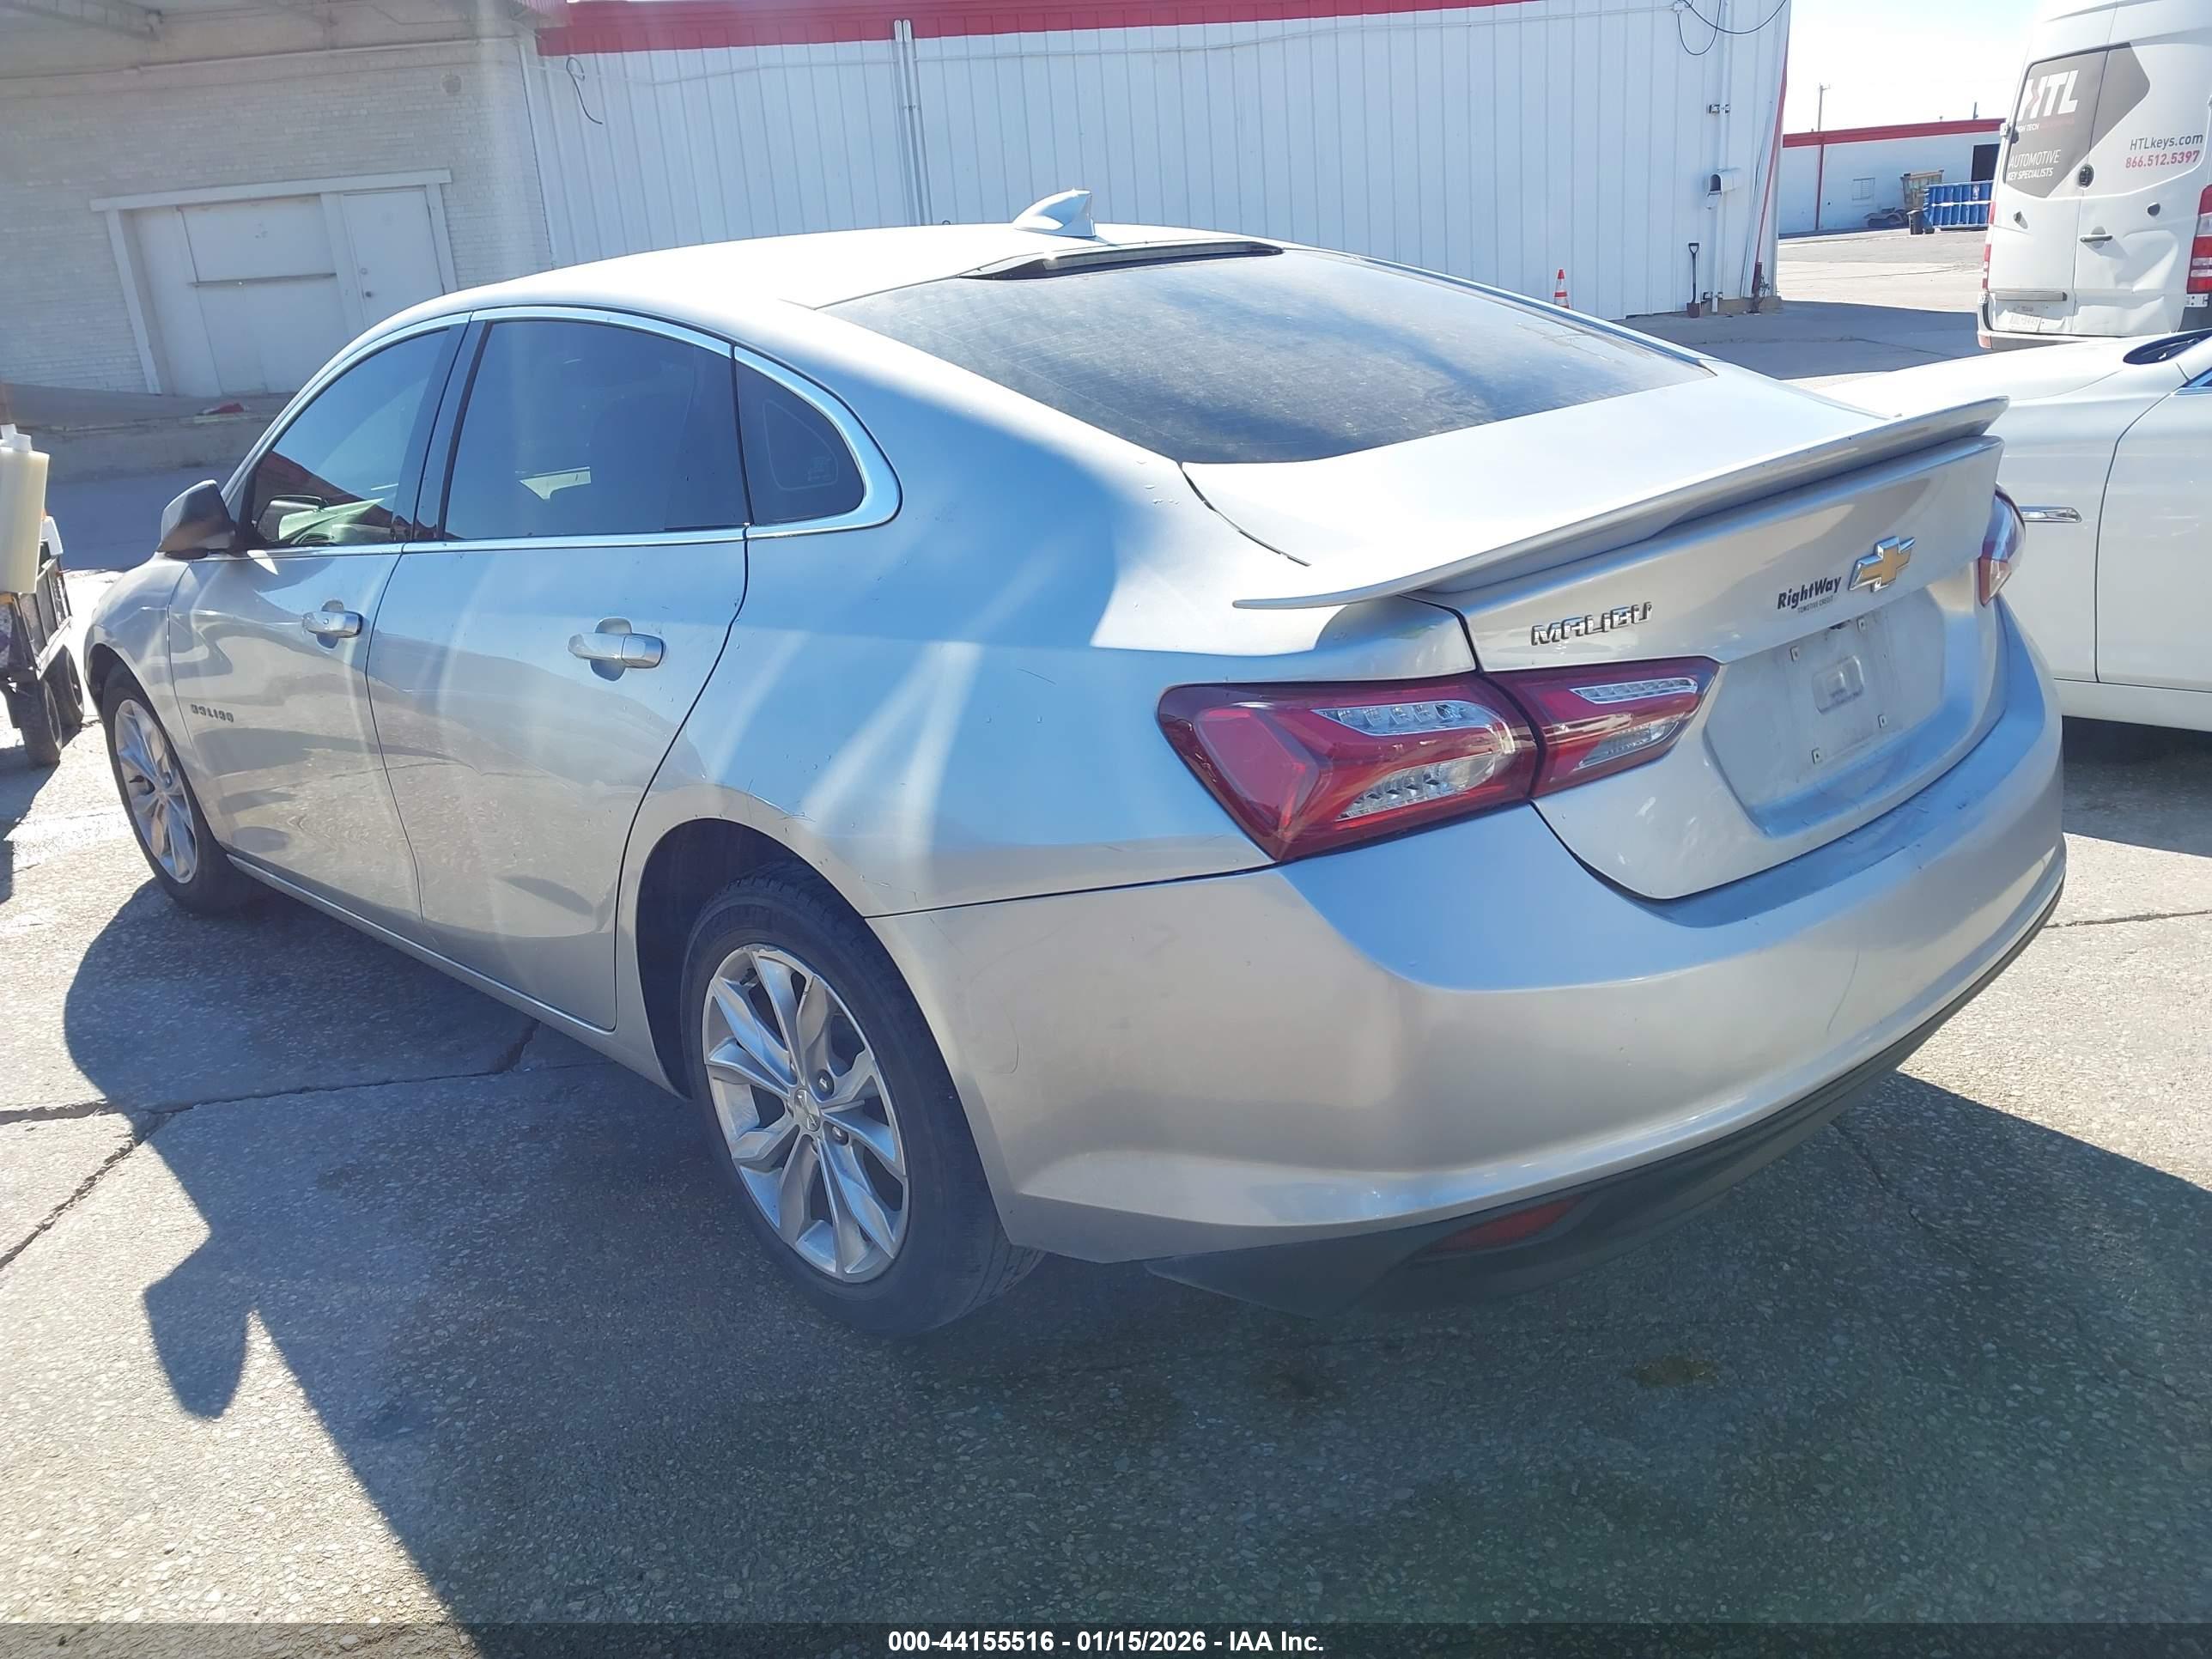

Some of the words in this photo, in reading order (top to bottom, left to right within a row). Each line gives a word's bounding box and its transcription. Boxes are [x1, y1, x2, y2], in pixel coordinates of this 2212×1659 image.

[2016, 70, 2080, 121] HTL
[2130, 133, 2203, 151] HTLkeys.com
[2008, 149, 2062, 169] AUTOMOTIVE
[2125, 149, 2200, 169] 866.512.5397
[2018, 167, 2054, 179] SPECIALISTS
[1778, 576, 1842, 611] RightWay
[1531, 601, 1652, 646] MALIBU
